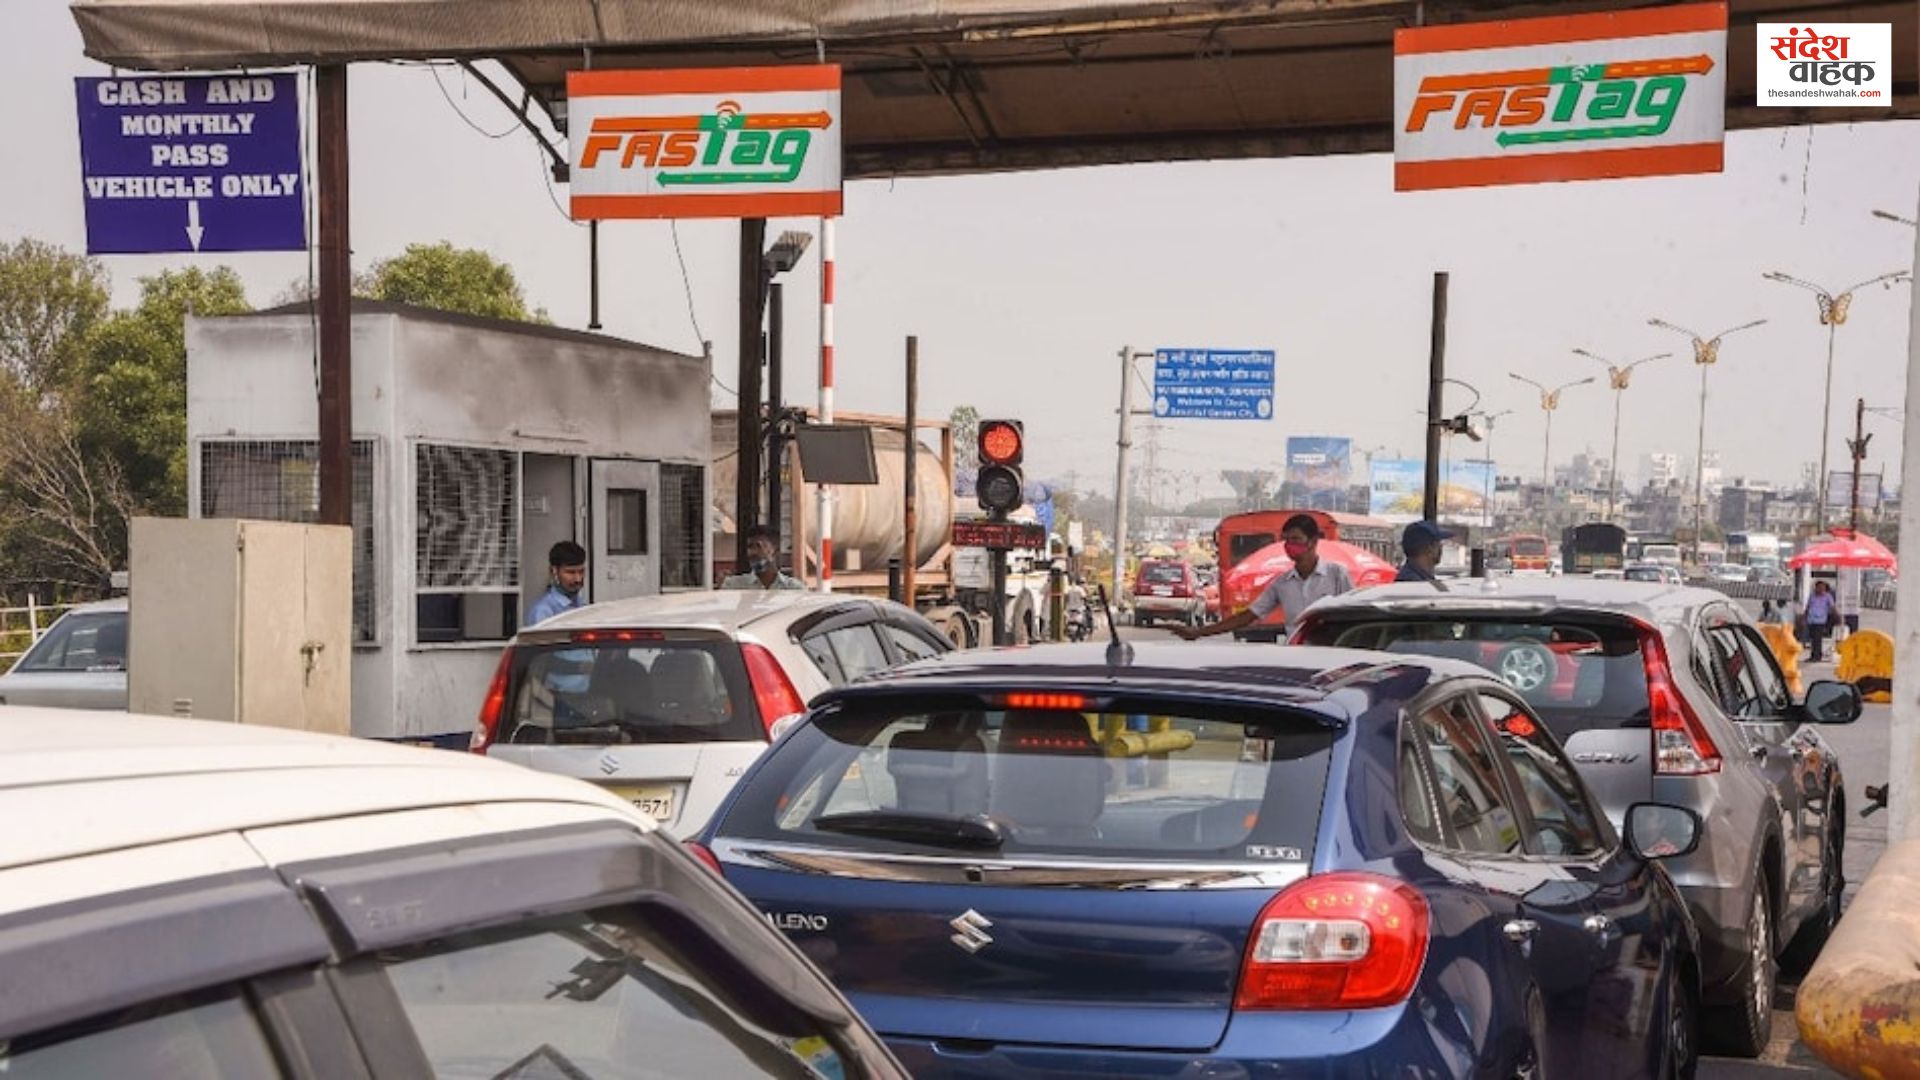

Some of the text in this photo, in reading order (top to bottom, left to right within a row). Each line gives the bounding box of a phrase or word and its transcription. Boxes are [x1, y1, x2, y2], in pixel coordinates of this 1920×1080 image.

[97, 78, 275, 106] CASH AND
[121, 113, 255, 136] MONTHLY
[151, 144, 229, 166] PASS
[85, 174, 299, 198] VEHICLE ONLY
[765, 912, 828, 931] ALENO
